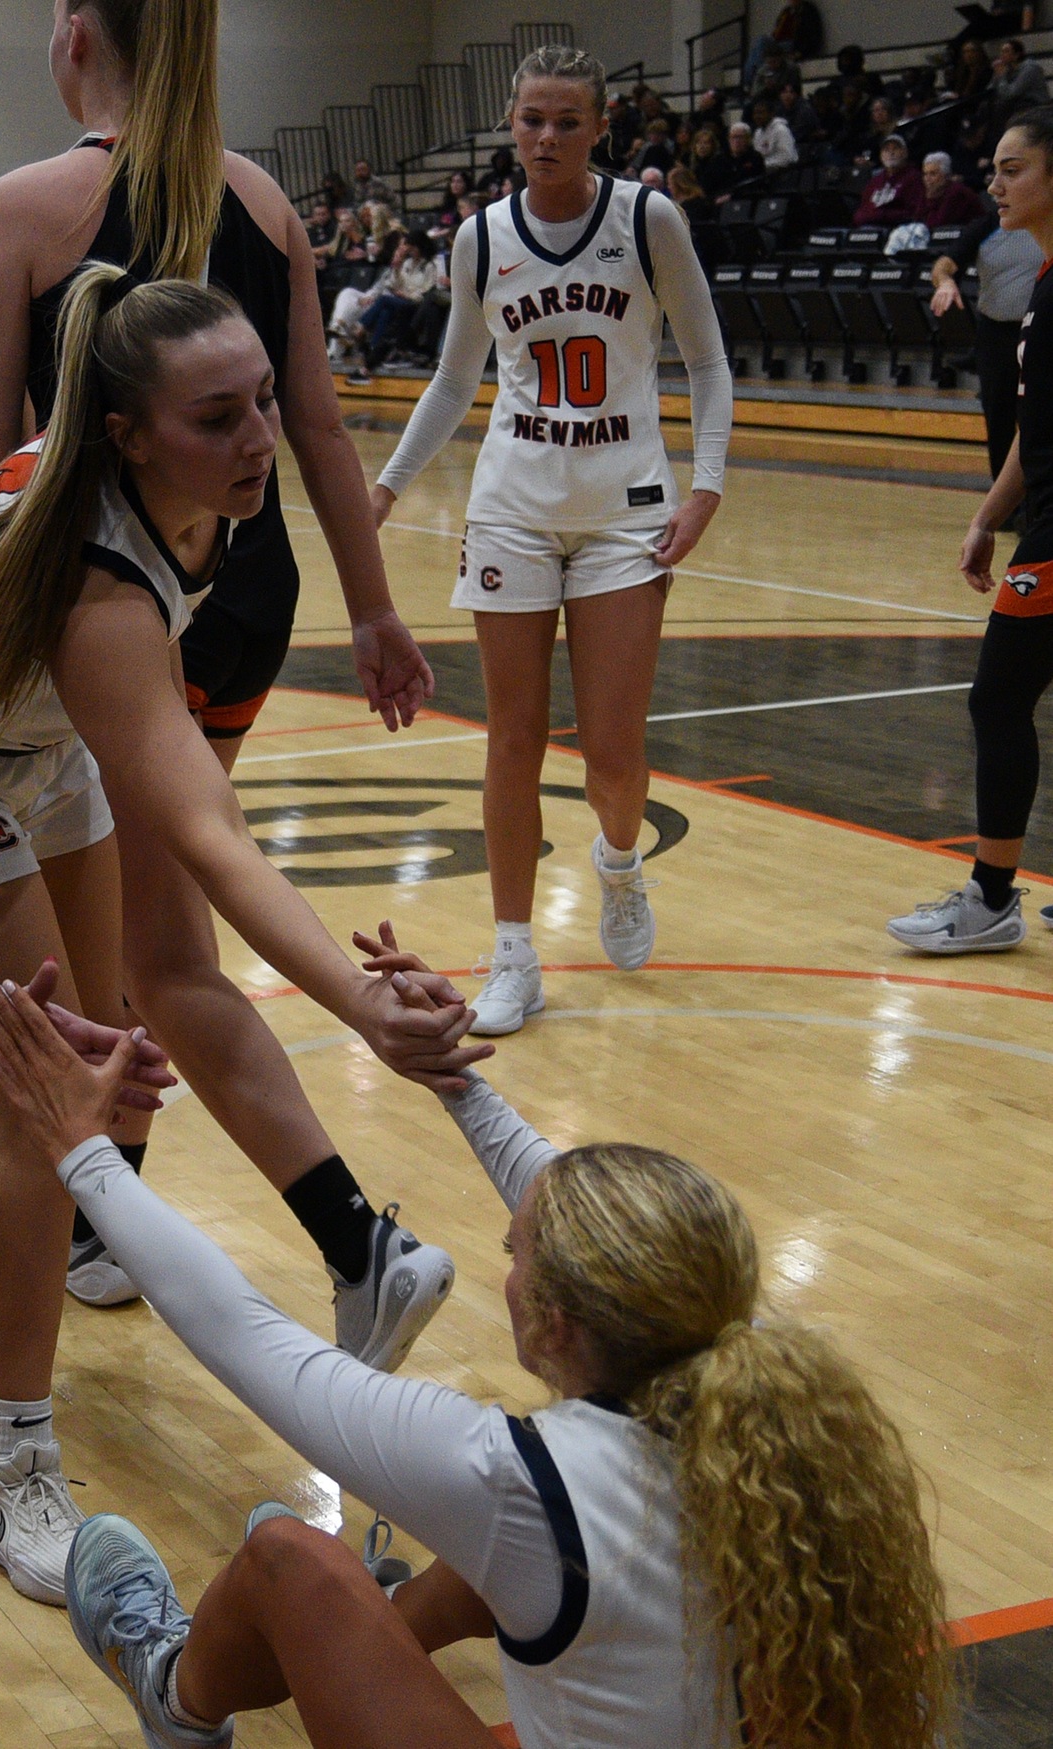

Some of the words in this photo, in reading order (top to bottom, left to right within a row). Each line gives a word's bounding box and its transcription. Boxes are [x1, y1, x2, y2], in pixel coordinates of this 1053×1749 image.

[600, 248, 625, 258] SAC
[502, 283, 630, 333] CARSON
[528, 335, 606, 408] 10
[513, 414, 630, 448] NEWMAN
